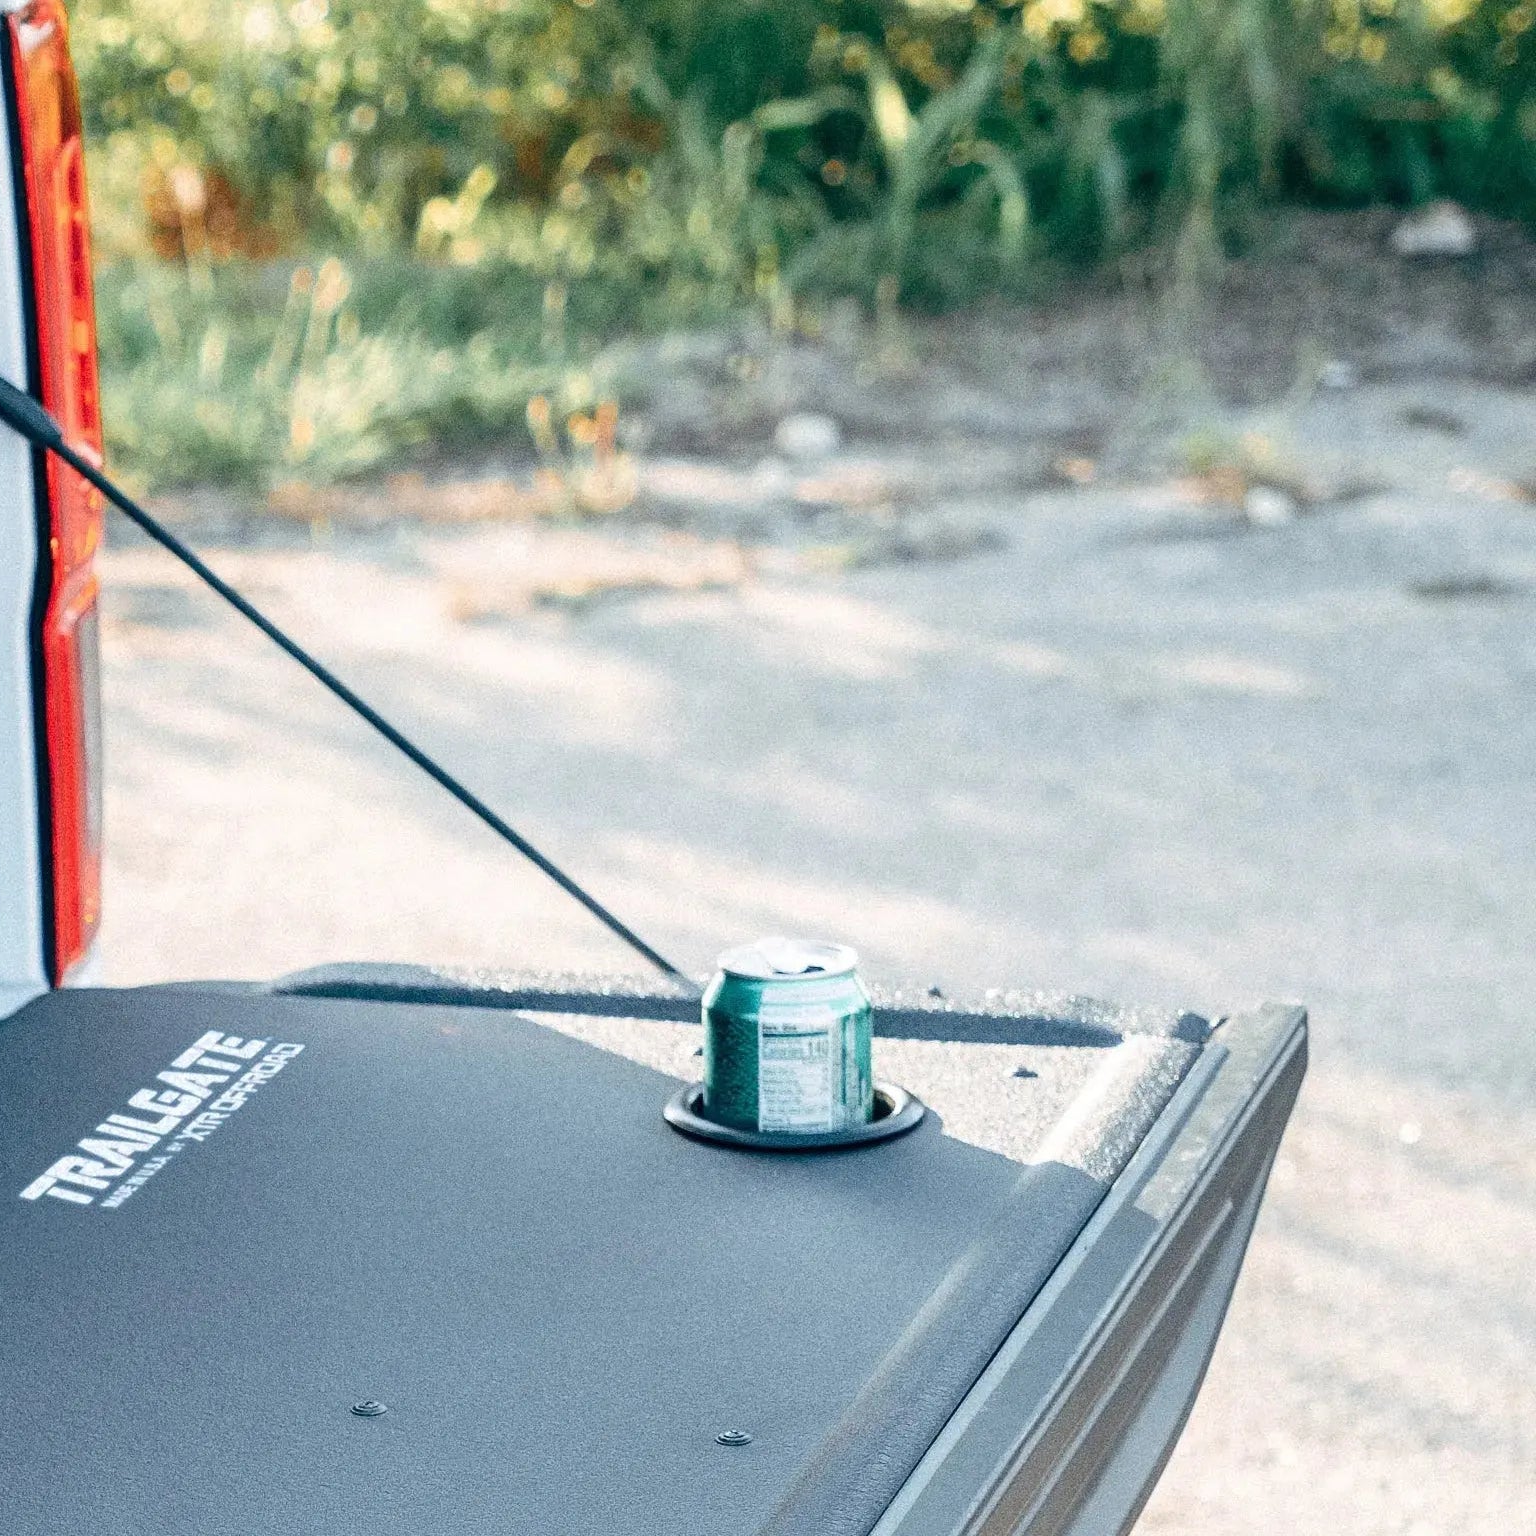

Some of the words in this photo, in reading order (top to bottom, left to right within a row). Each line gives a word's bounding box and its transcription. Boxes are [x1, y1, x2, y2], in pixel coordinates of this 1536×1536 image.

[19, 1030, 267, 1205] TRAILGATE
[174, 1111, 232, 1142] XTR
[209, 1042, 306, 1112] OFFROAD
